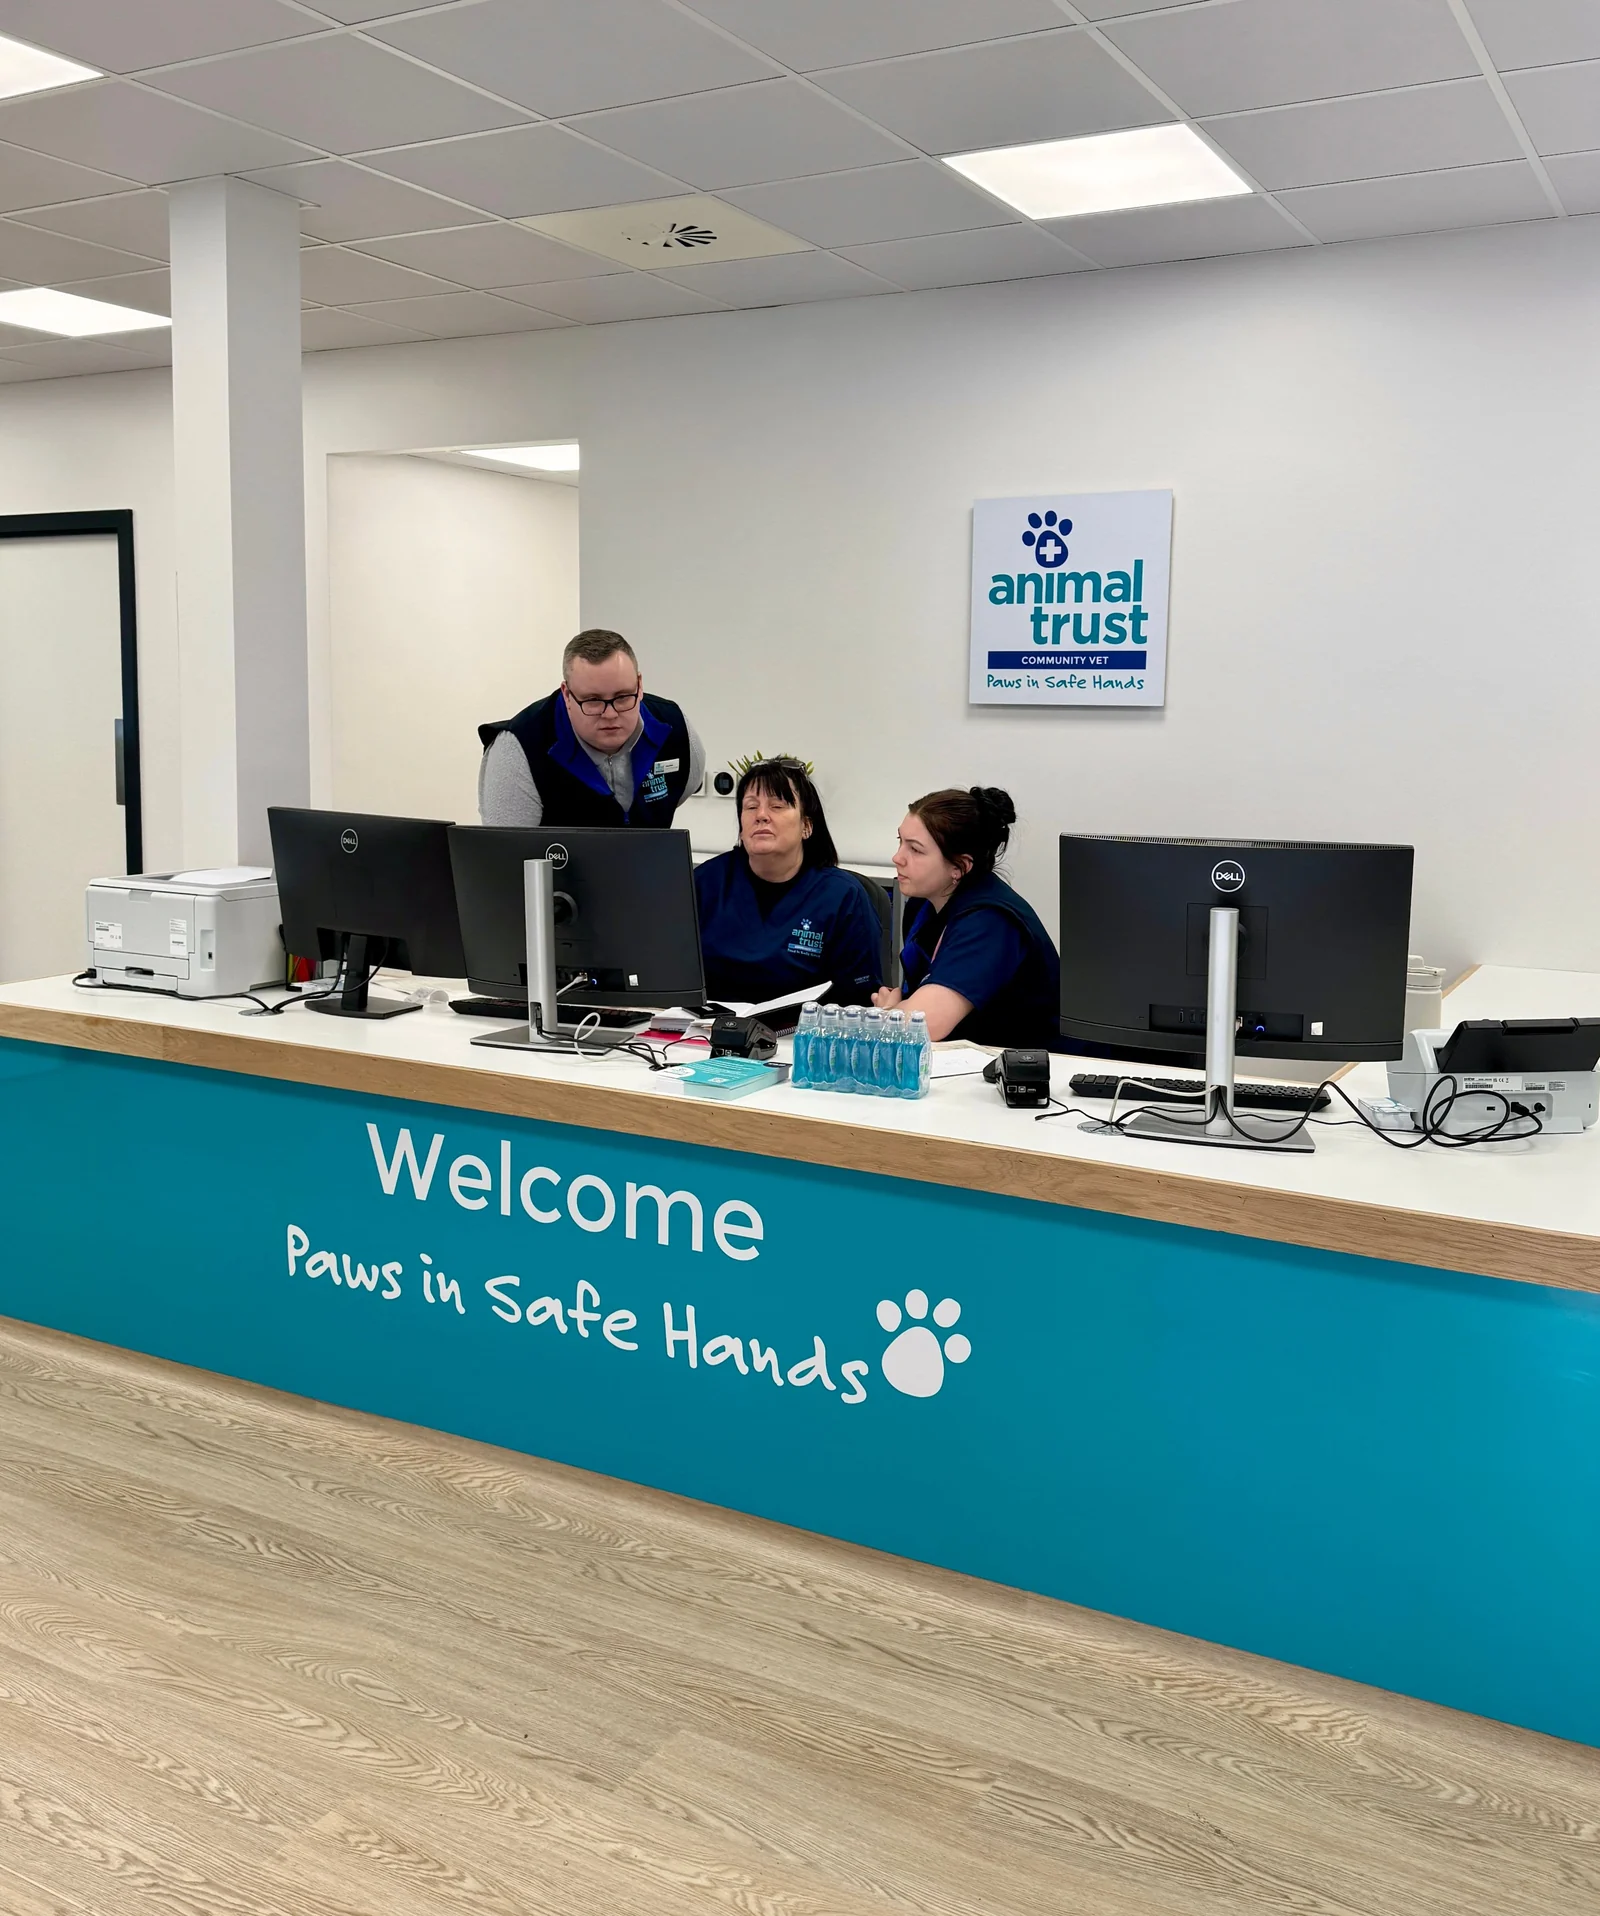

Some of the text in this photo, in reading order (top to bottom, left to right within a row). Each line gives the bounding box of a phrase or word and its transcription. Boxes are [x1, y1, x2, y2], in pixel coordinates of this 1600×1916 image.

[988, 559, 1143, 605] animal
[1030, 605, 1148, 645] trust
[1021, 656, 1109, 665] COMMUNITY VET
[987, 674, 1145, 690] Paws in Safe Hands
[1215, 871, 1242, 881] DELL
[791, 928, 824, 940] animal
[366, 1122, 764, 1261] Welcome
[287, 1224, 869, 1404] Paws in Safe Hands
